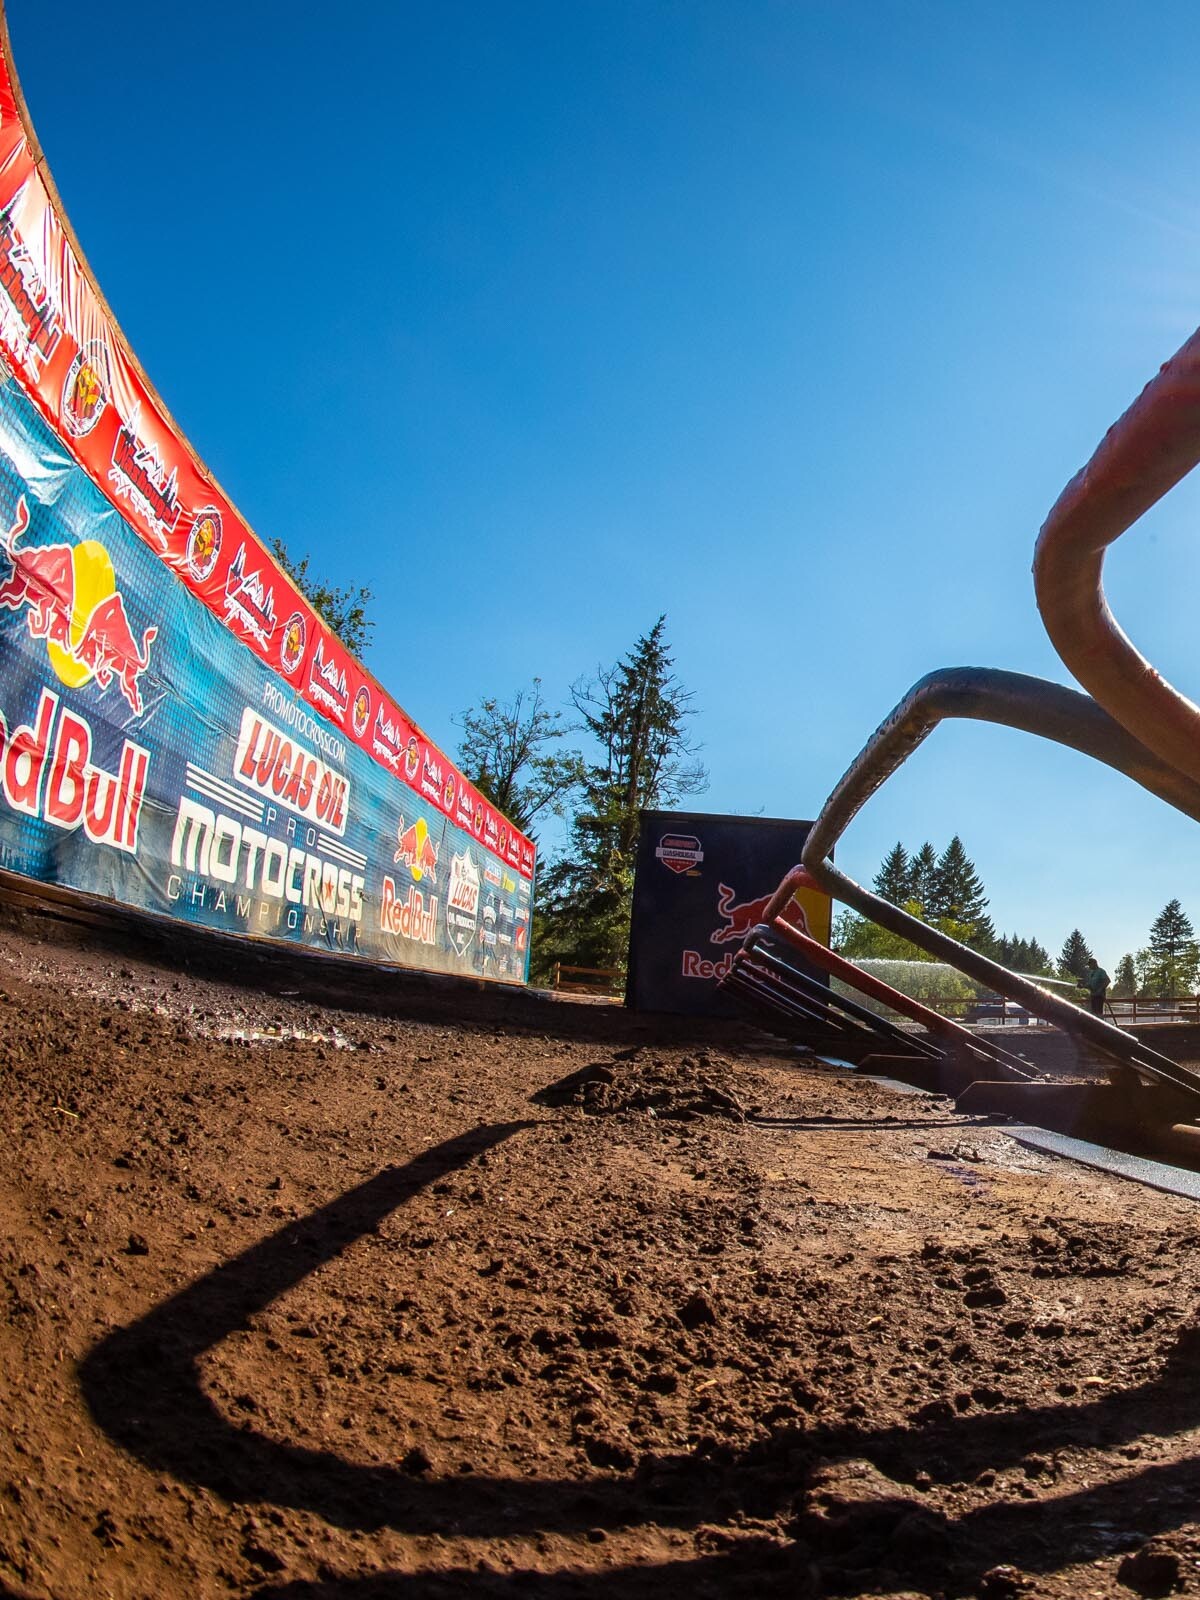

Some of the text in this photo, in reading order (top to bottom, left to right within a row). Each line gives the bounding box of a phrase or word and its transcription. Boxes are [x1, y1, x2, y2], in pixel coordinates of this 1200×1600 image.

[113, 430, 181, 530] Washougal
[240, 720, 317, 811] LUCAS
[316, 771, 346, 829] OIL
[171, 796, 365, 921] MOTOCROSS
[266, 807, 316, 846] PRO
[167, 874, 361, 941] CHAMPIONSHIP
[452, 880, 477, 910] LUCAS
